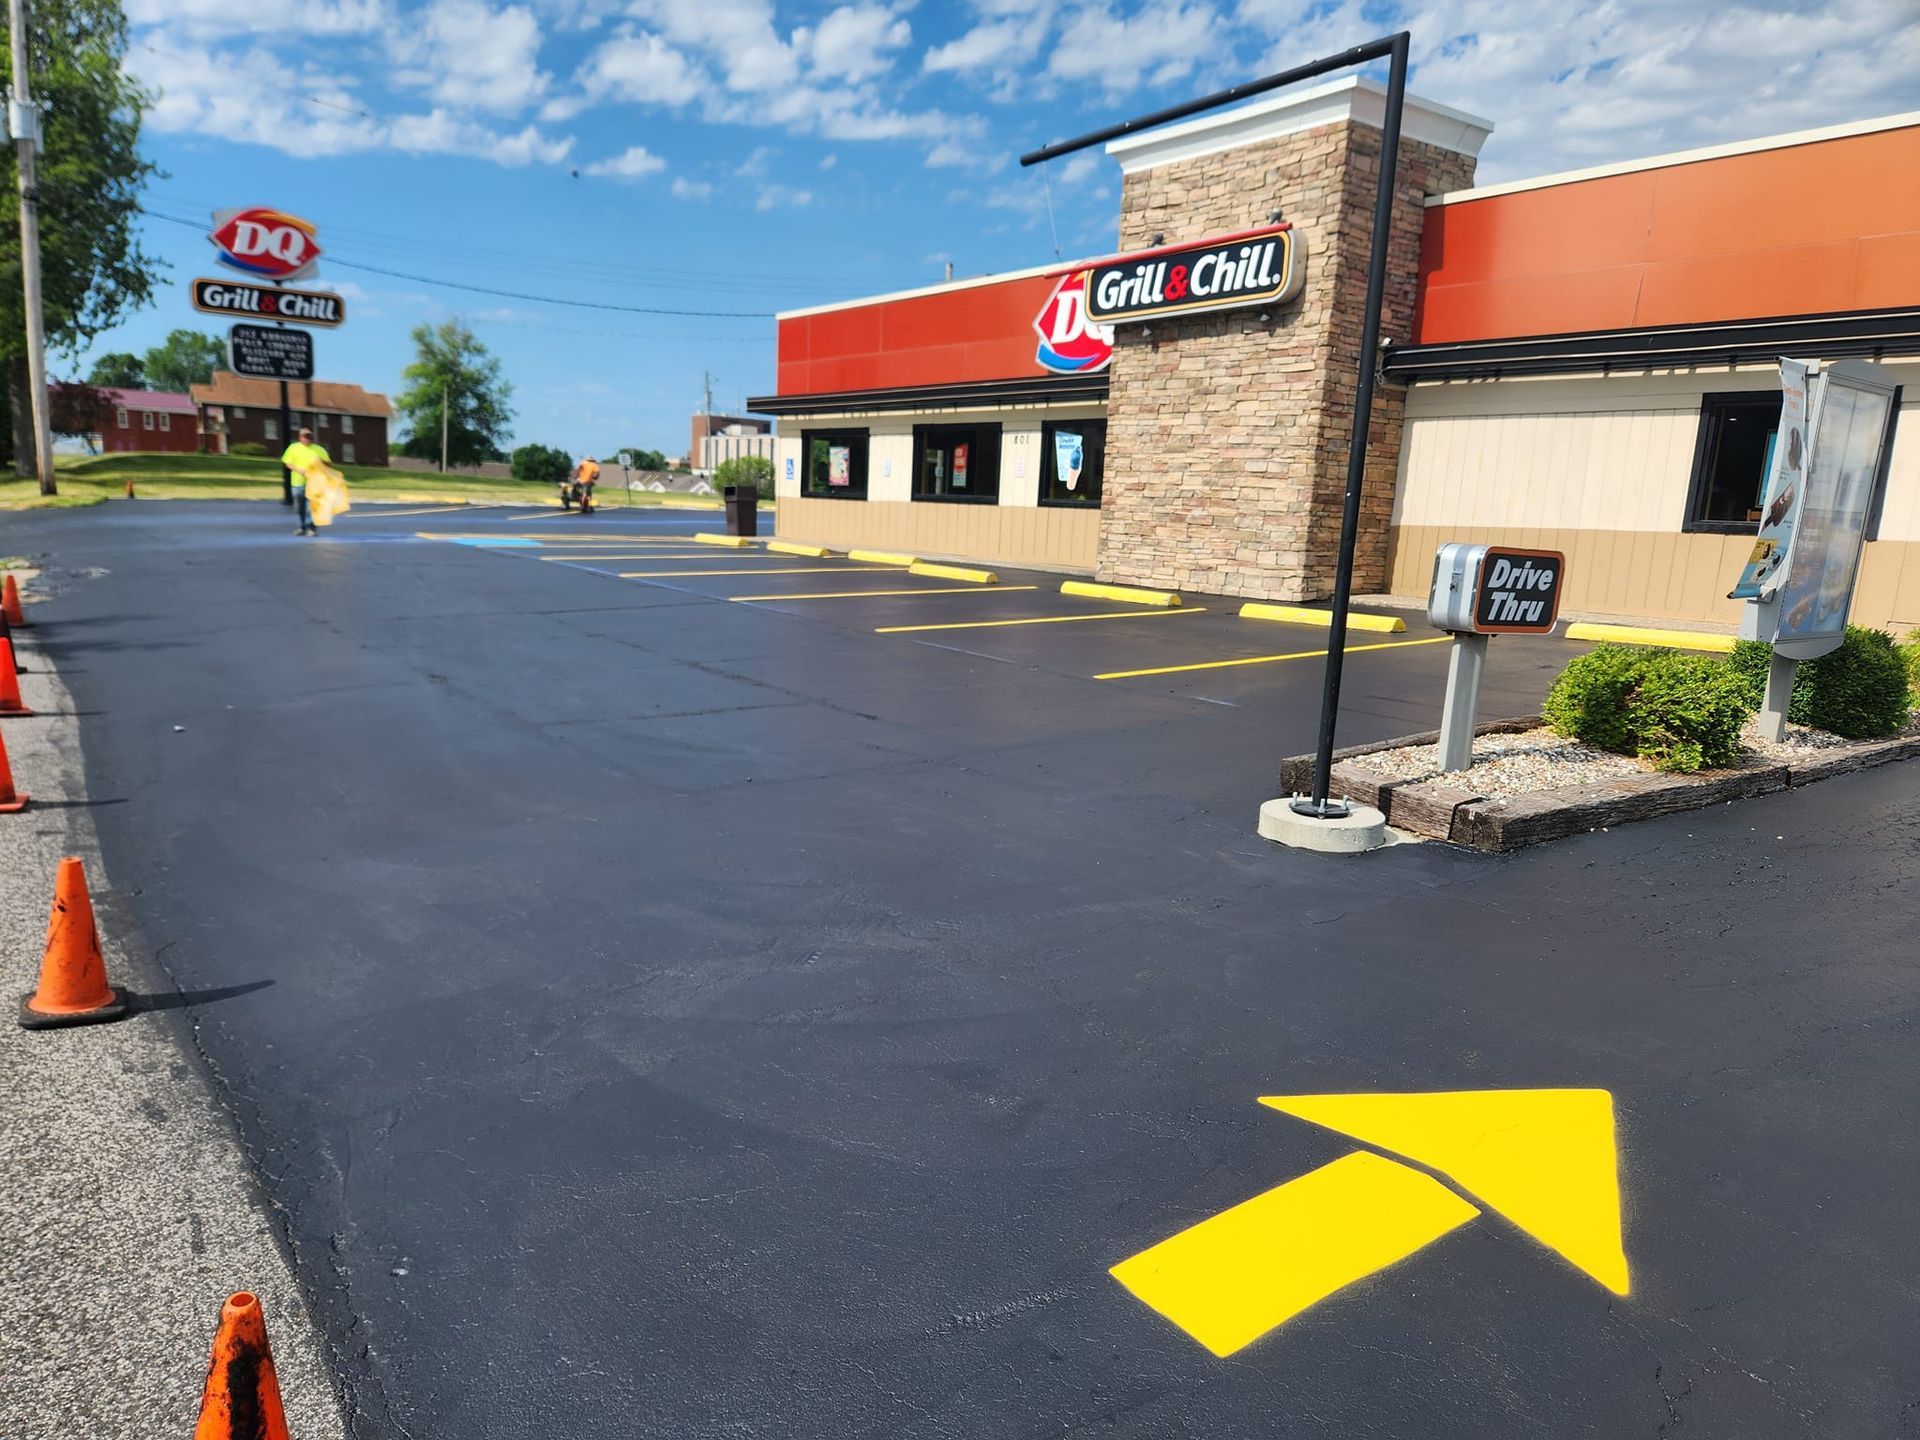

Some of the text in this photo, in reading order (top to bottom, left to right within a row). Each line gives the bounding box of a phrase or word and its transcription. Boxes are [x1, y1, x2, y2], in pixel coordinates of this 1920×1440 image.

[232, 220, 305, 266] DQ
[203, 284, 260, 312] Grill
[279, 294, 335, 320] Chill
[1097, 261, 1167, 310] Grill
[1164, 265, 1187, 301] &
[1488, 559, 1554, 591] Drive
[1487, 592, 1545, 622] Thru
